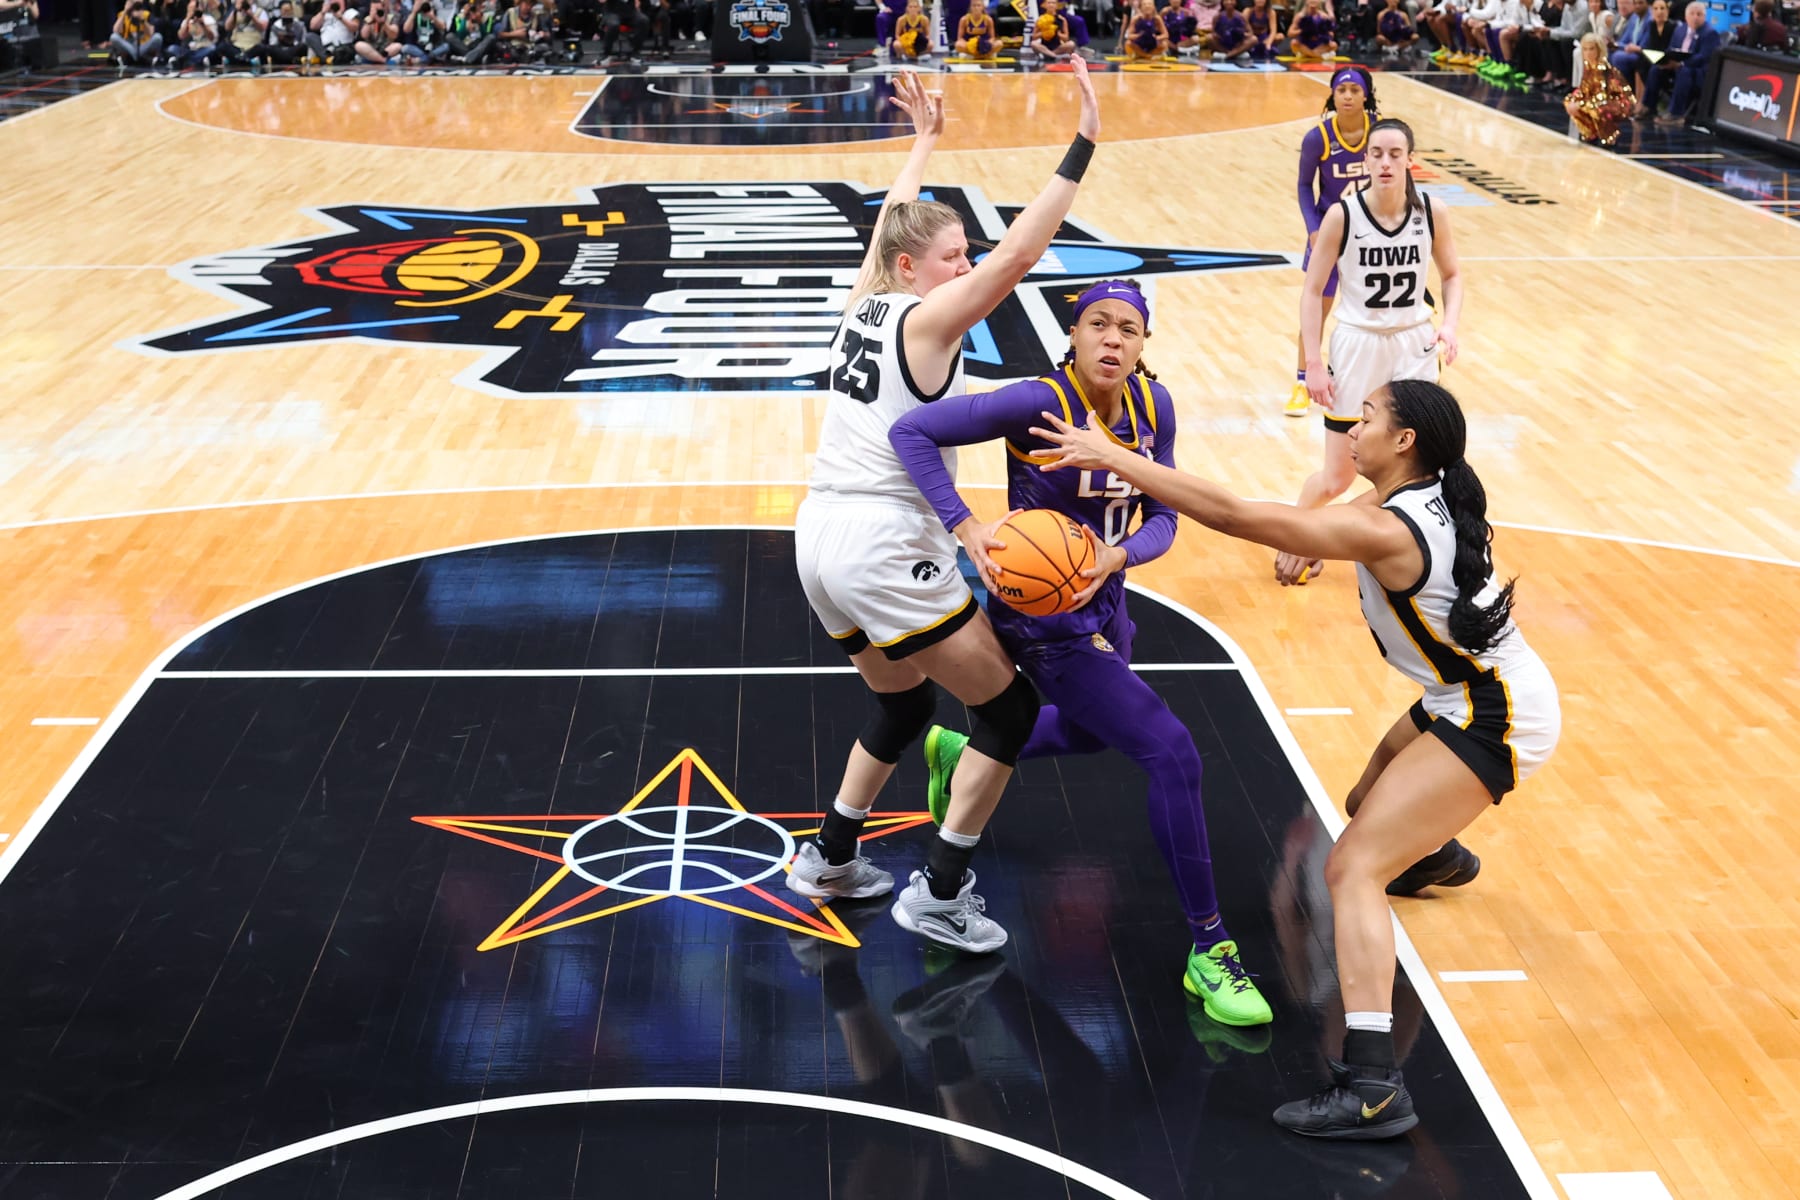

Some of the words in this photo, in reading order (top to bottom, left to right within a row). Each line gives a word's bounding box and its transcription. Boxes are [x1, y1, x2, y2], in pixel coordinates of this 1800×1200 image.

[732, 10, 760, 24] FINAL
[760, 10, 787, 23] FOUR
[644, 64, 1015, 74] FINAL
[1340, 180, 1370, 200] 4
[645, 185, 865, 259] FINAL
[558, 242, 620, 286] DALLAS
[1358, 245, 1421, 267] IOWA
[1364, 271, 1417, 309] 22
[563, 268, 862, 382] FOUR
[833, 328, 883, 405] 25
[1104, 499, 1130, 547] 0
